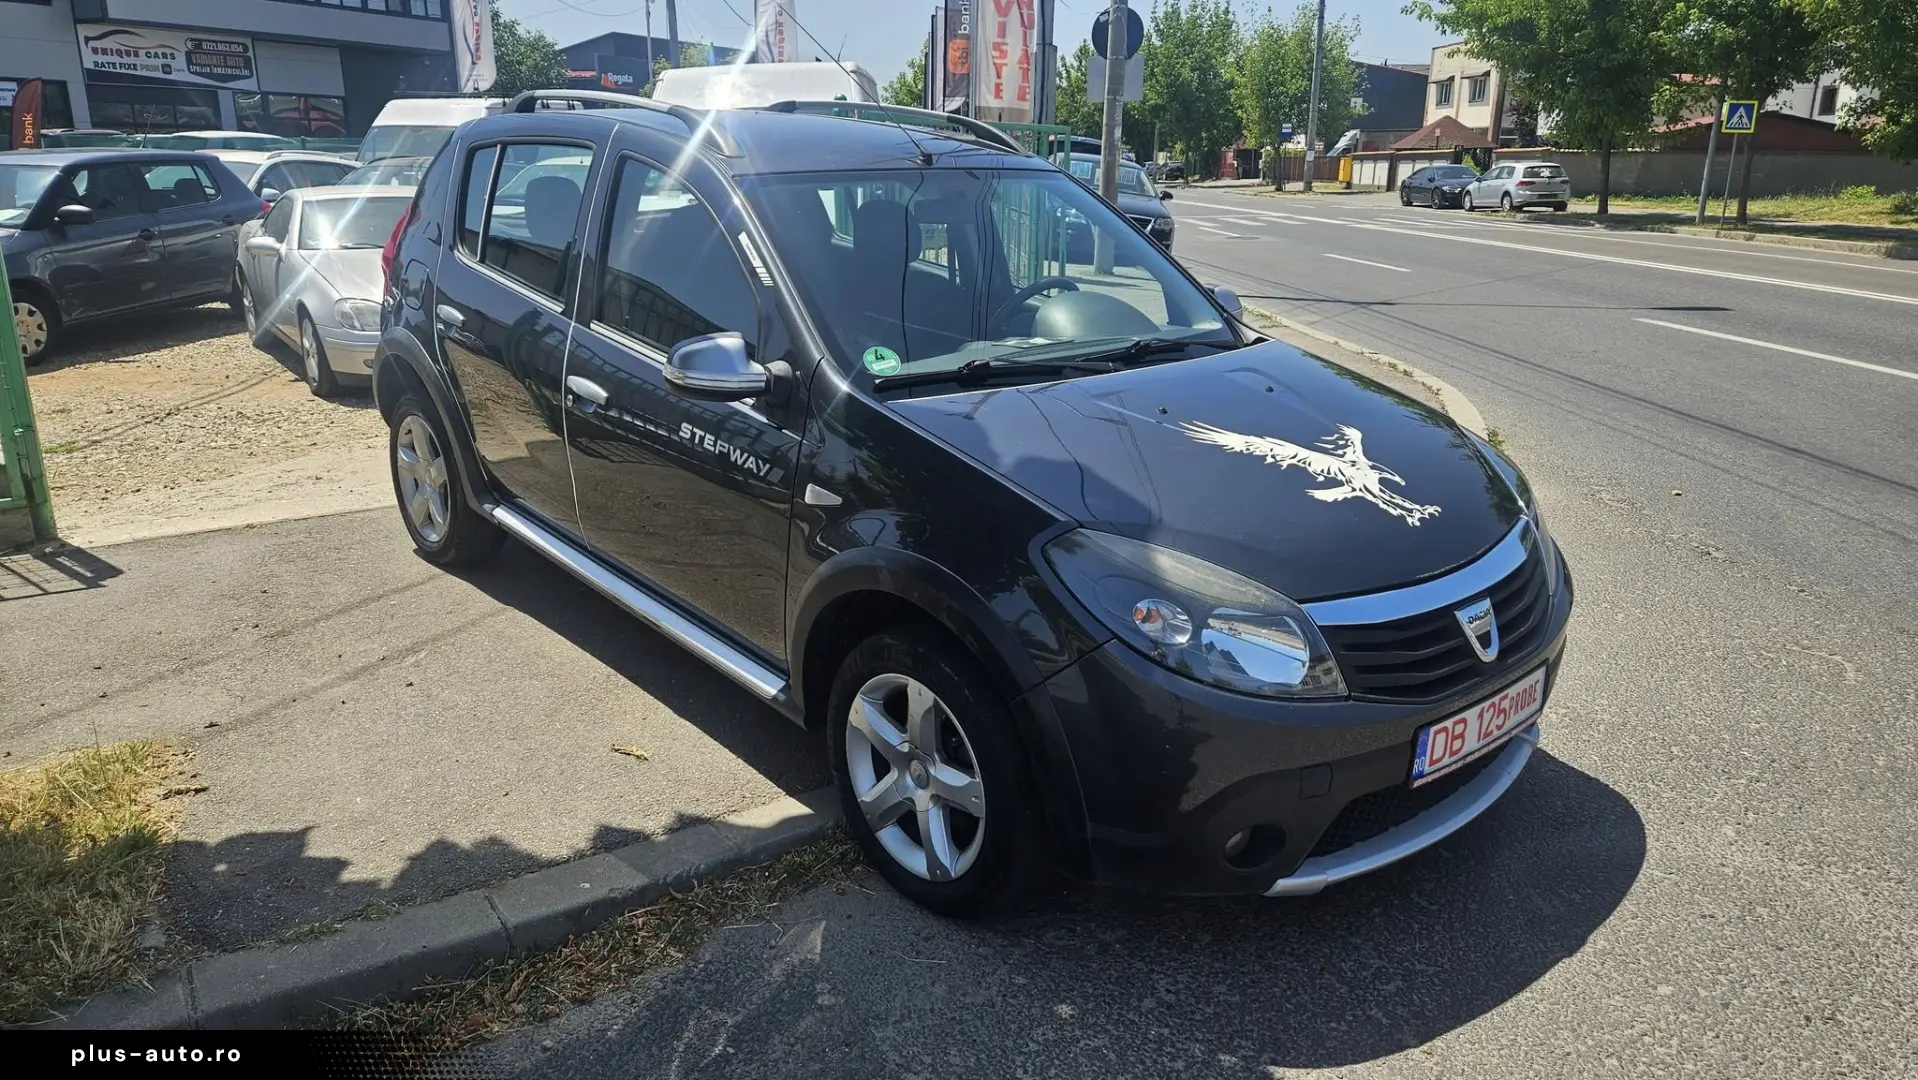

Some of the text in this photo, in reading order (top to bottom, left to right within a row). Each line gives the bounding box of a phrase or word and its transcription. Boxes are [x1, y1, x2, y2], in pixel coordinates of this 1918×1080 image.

[91, 46, 176, 60] UNIQUE CARS
[93, 60, 118, 70] RATE
[118, 62, 138, 71] FIXE
[607, 72, 633, 85] Regata
[22, 112, 35, 144] bank
[874, 349, 885, 361] 4
[679, 422, 770, 477] STEPWAY
[1467, 607, 1491, 624] DACIA
[1428, 679, 1540, 767] DB 125 PROBE
[1412, 756, 1426, 775] RO
